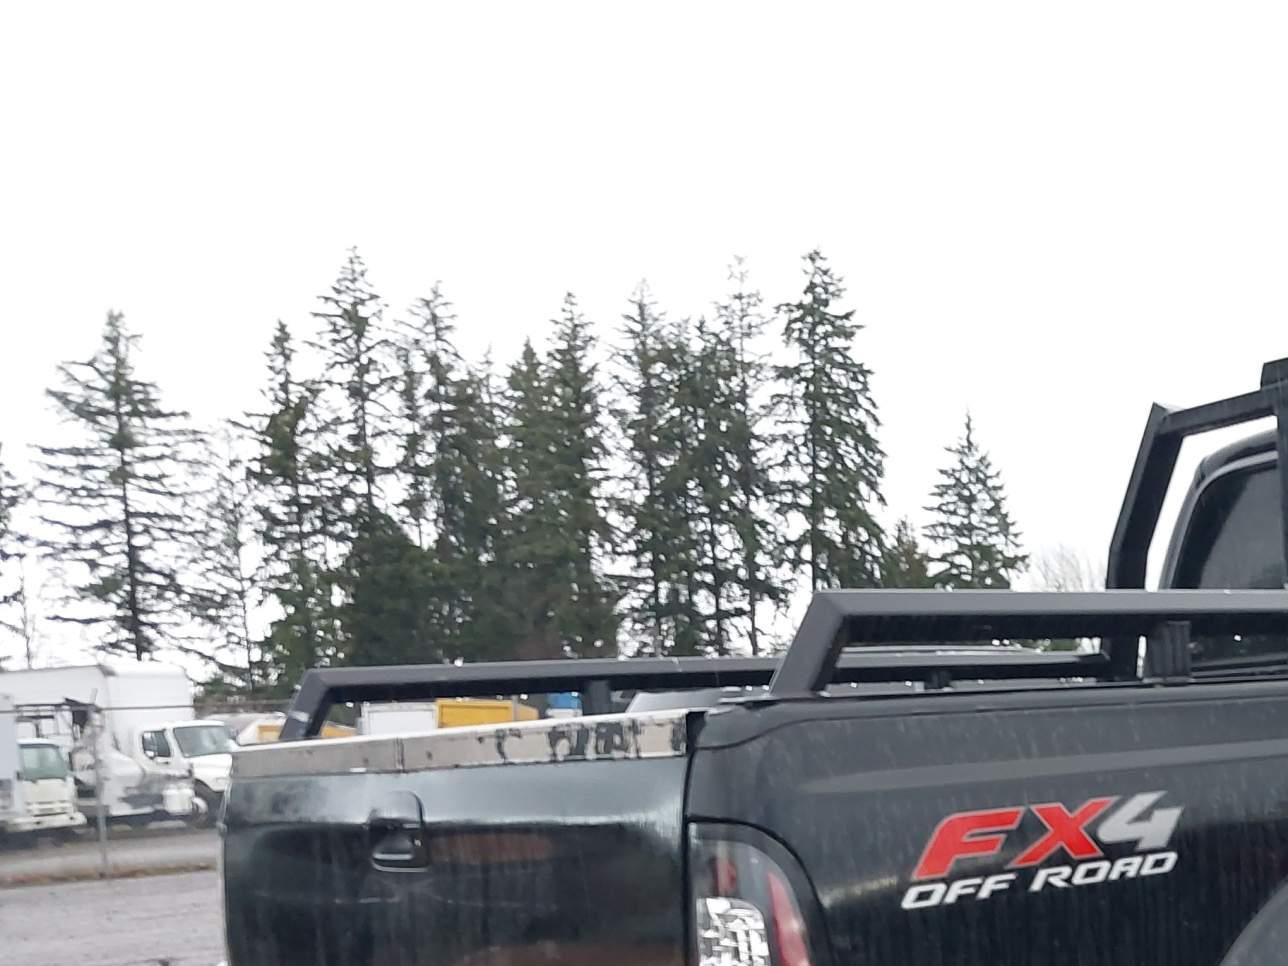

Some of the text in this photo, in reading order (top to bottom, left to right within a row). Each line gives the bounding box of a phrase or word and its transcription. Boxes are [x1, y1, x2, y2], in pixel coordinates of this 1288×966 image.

[911, 790, 1183, 881] FX4
[901, 851, 1179, 910] OFF ROAD
